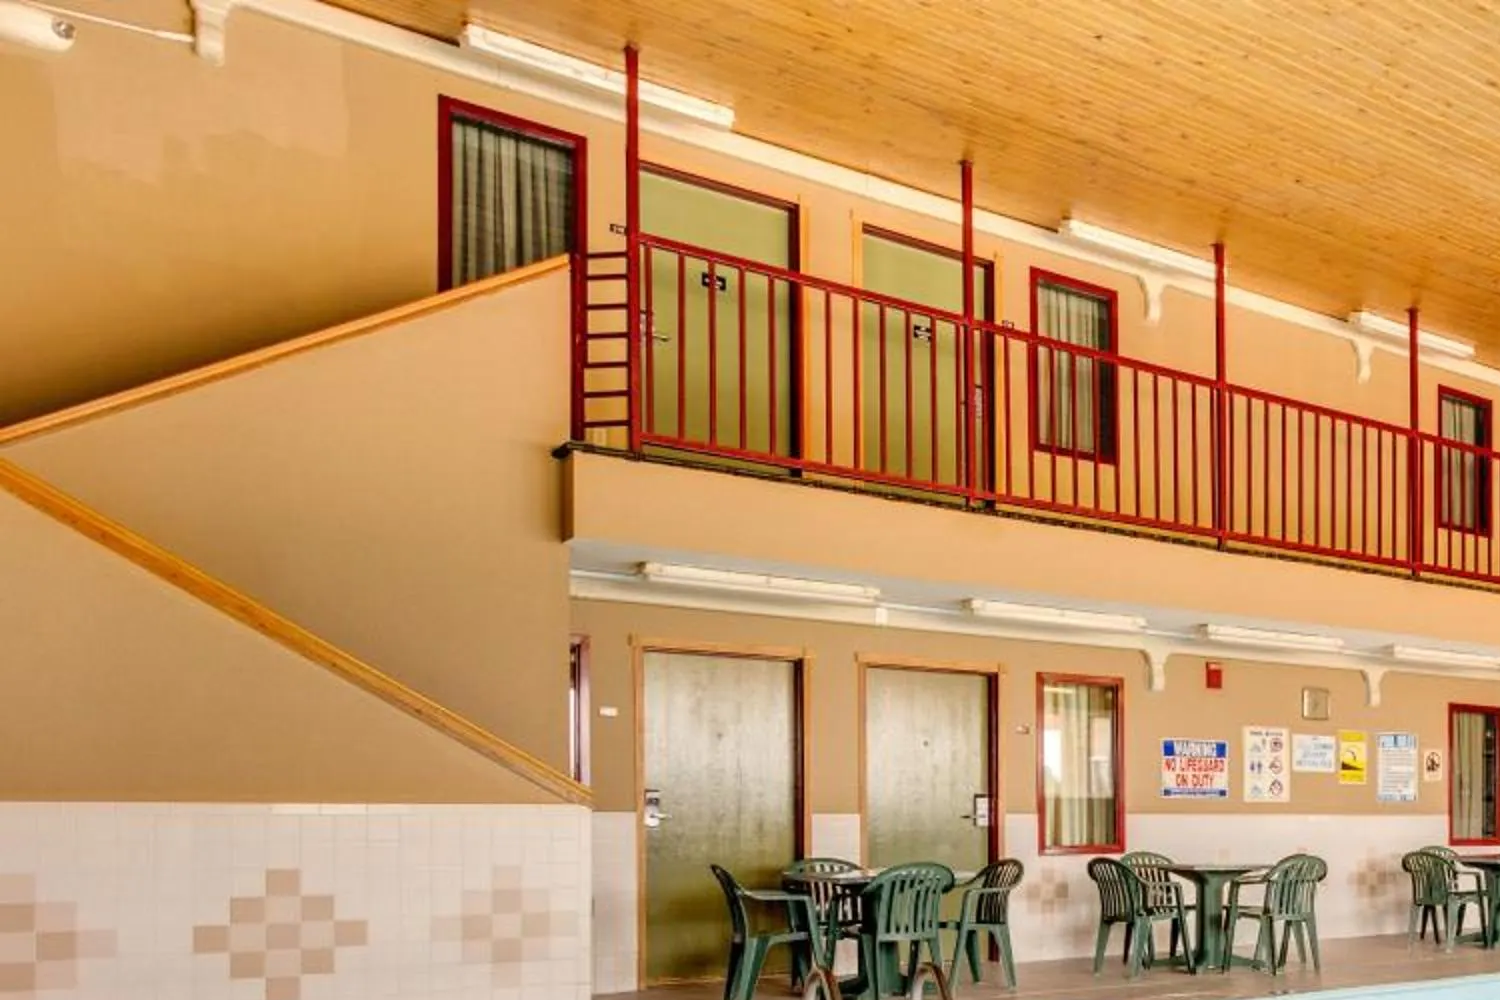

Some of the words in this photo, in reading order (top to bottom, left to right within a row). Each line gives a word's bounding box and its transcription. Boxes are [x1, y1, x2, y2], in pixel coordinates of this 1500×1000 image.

[1164, 758, 1177, 772] NO
[1180, 758, 1225, 773] LIFEGUARD
[1175, 773, 1188, 787] ON
[1191, 773, 1214, 788] DUTY
